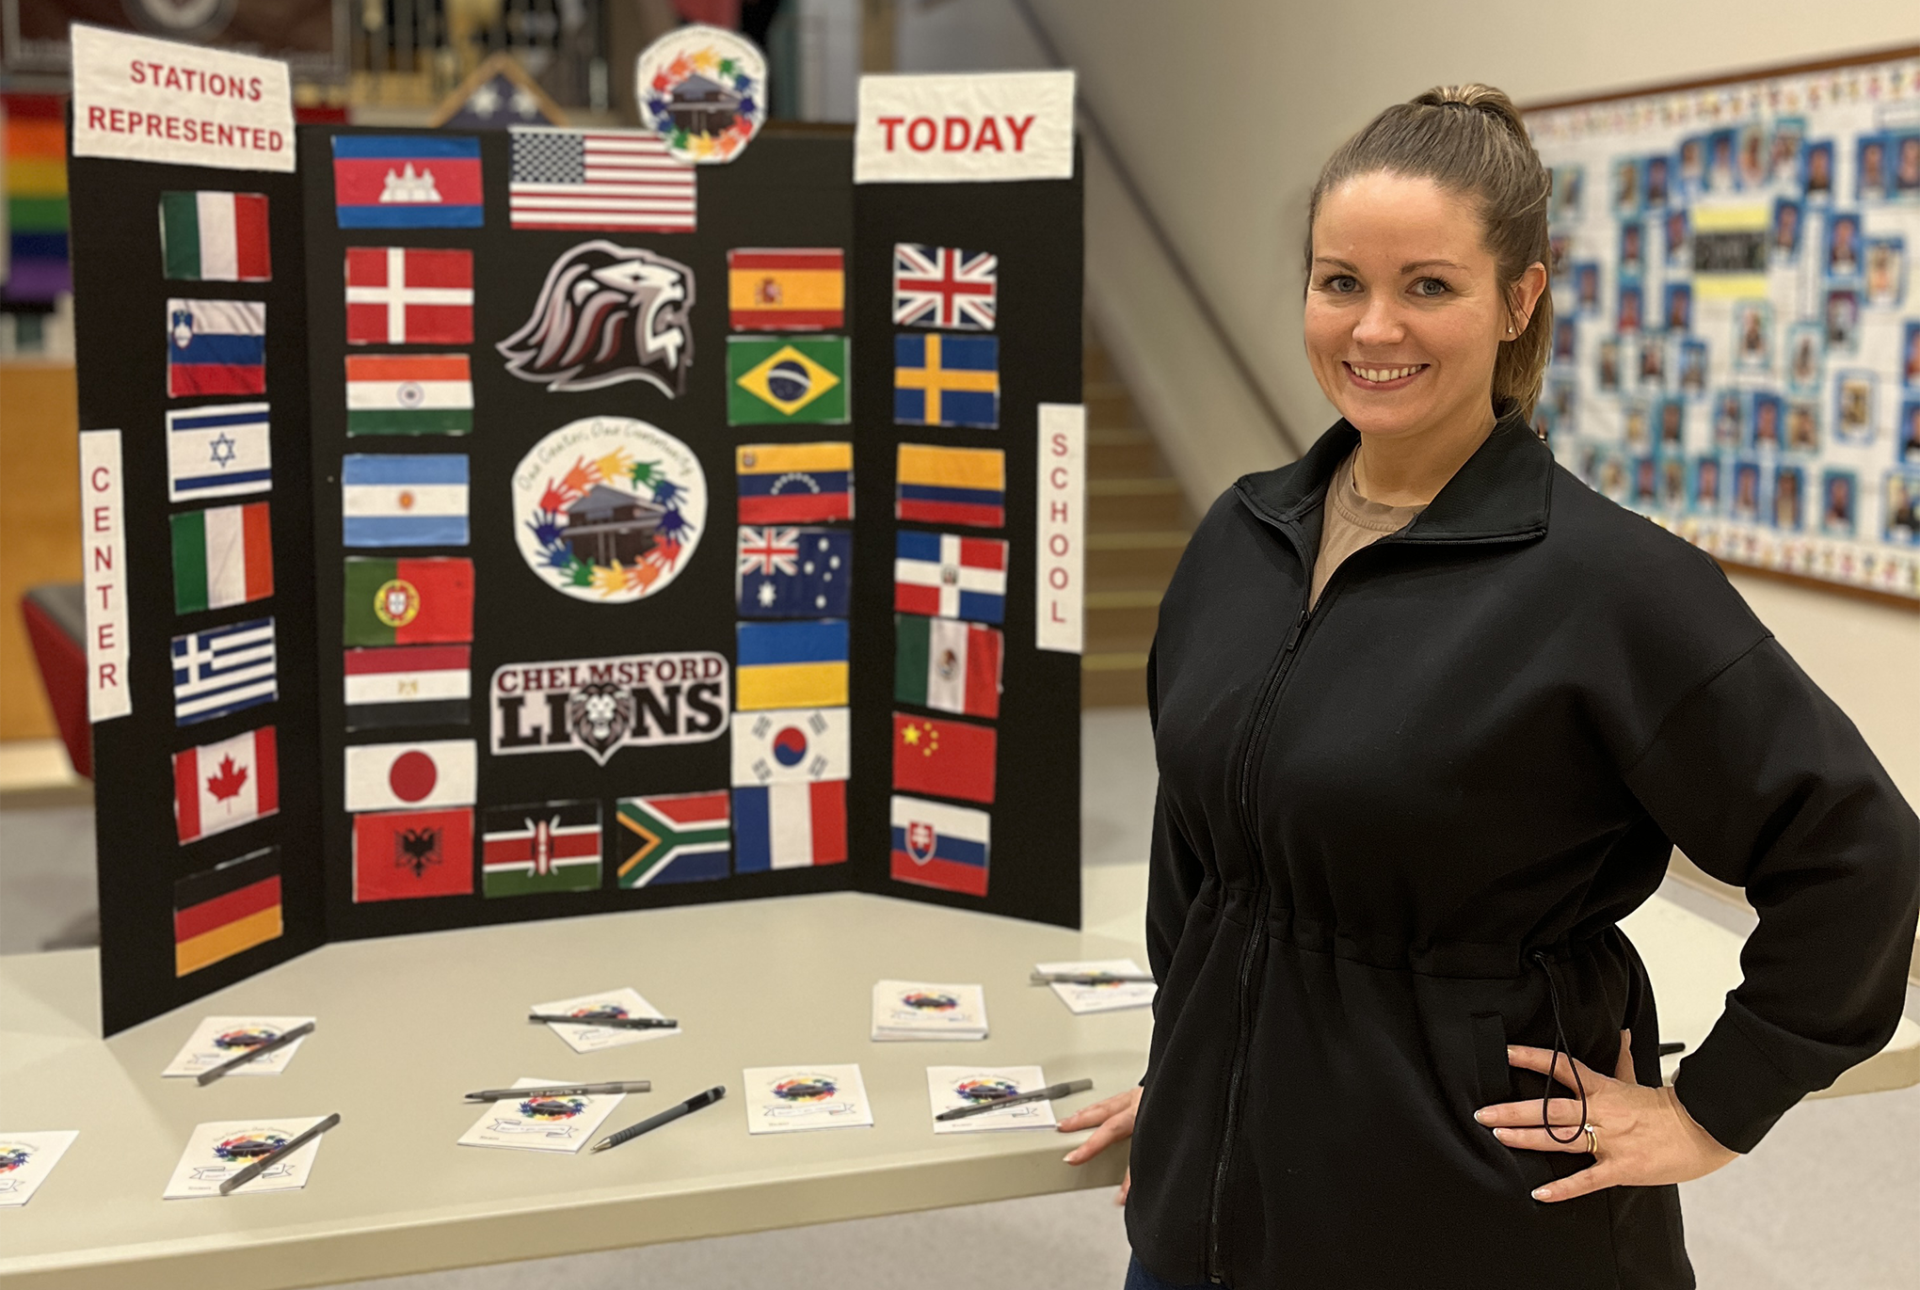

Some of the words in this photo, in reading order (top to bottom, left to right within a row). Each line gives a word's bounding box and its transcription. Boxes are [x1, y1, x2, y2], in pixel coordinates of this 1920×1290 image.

[130, 60, 262, 102] STATIONS
[88, 106, 284, 152] REPRESENTED
[877, 115, 1036, 153] TODAY
[1048, 432, 1070, 624] SCHOOL
[91, 466, 118, 690] CENTER
[497, 657, 724, 693] CHELMSFORD
